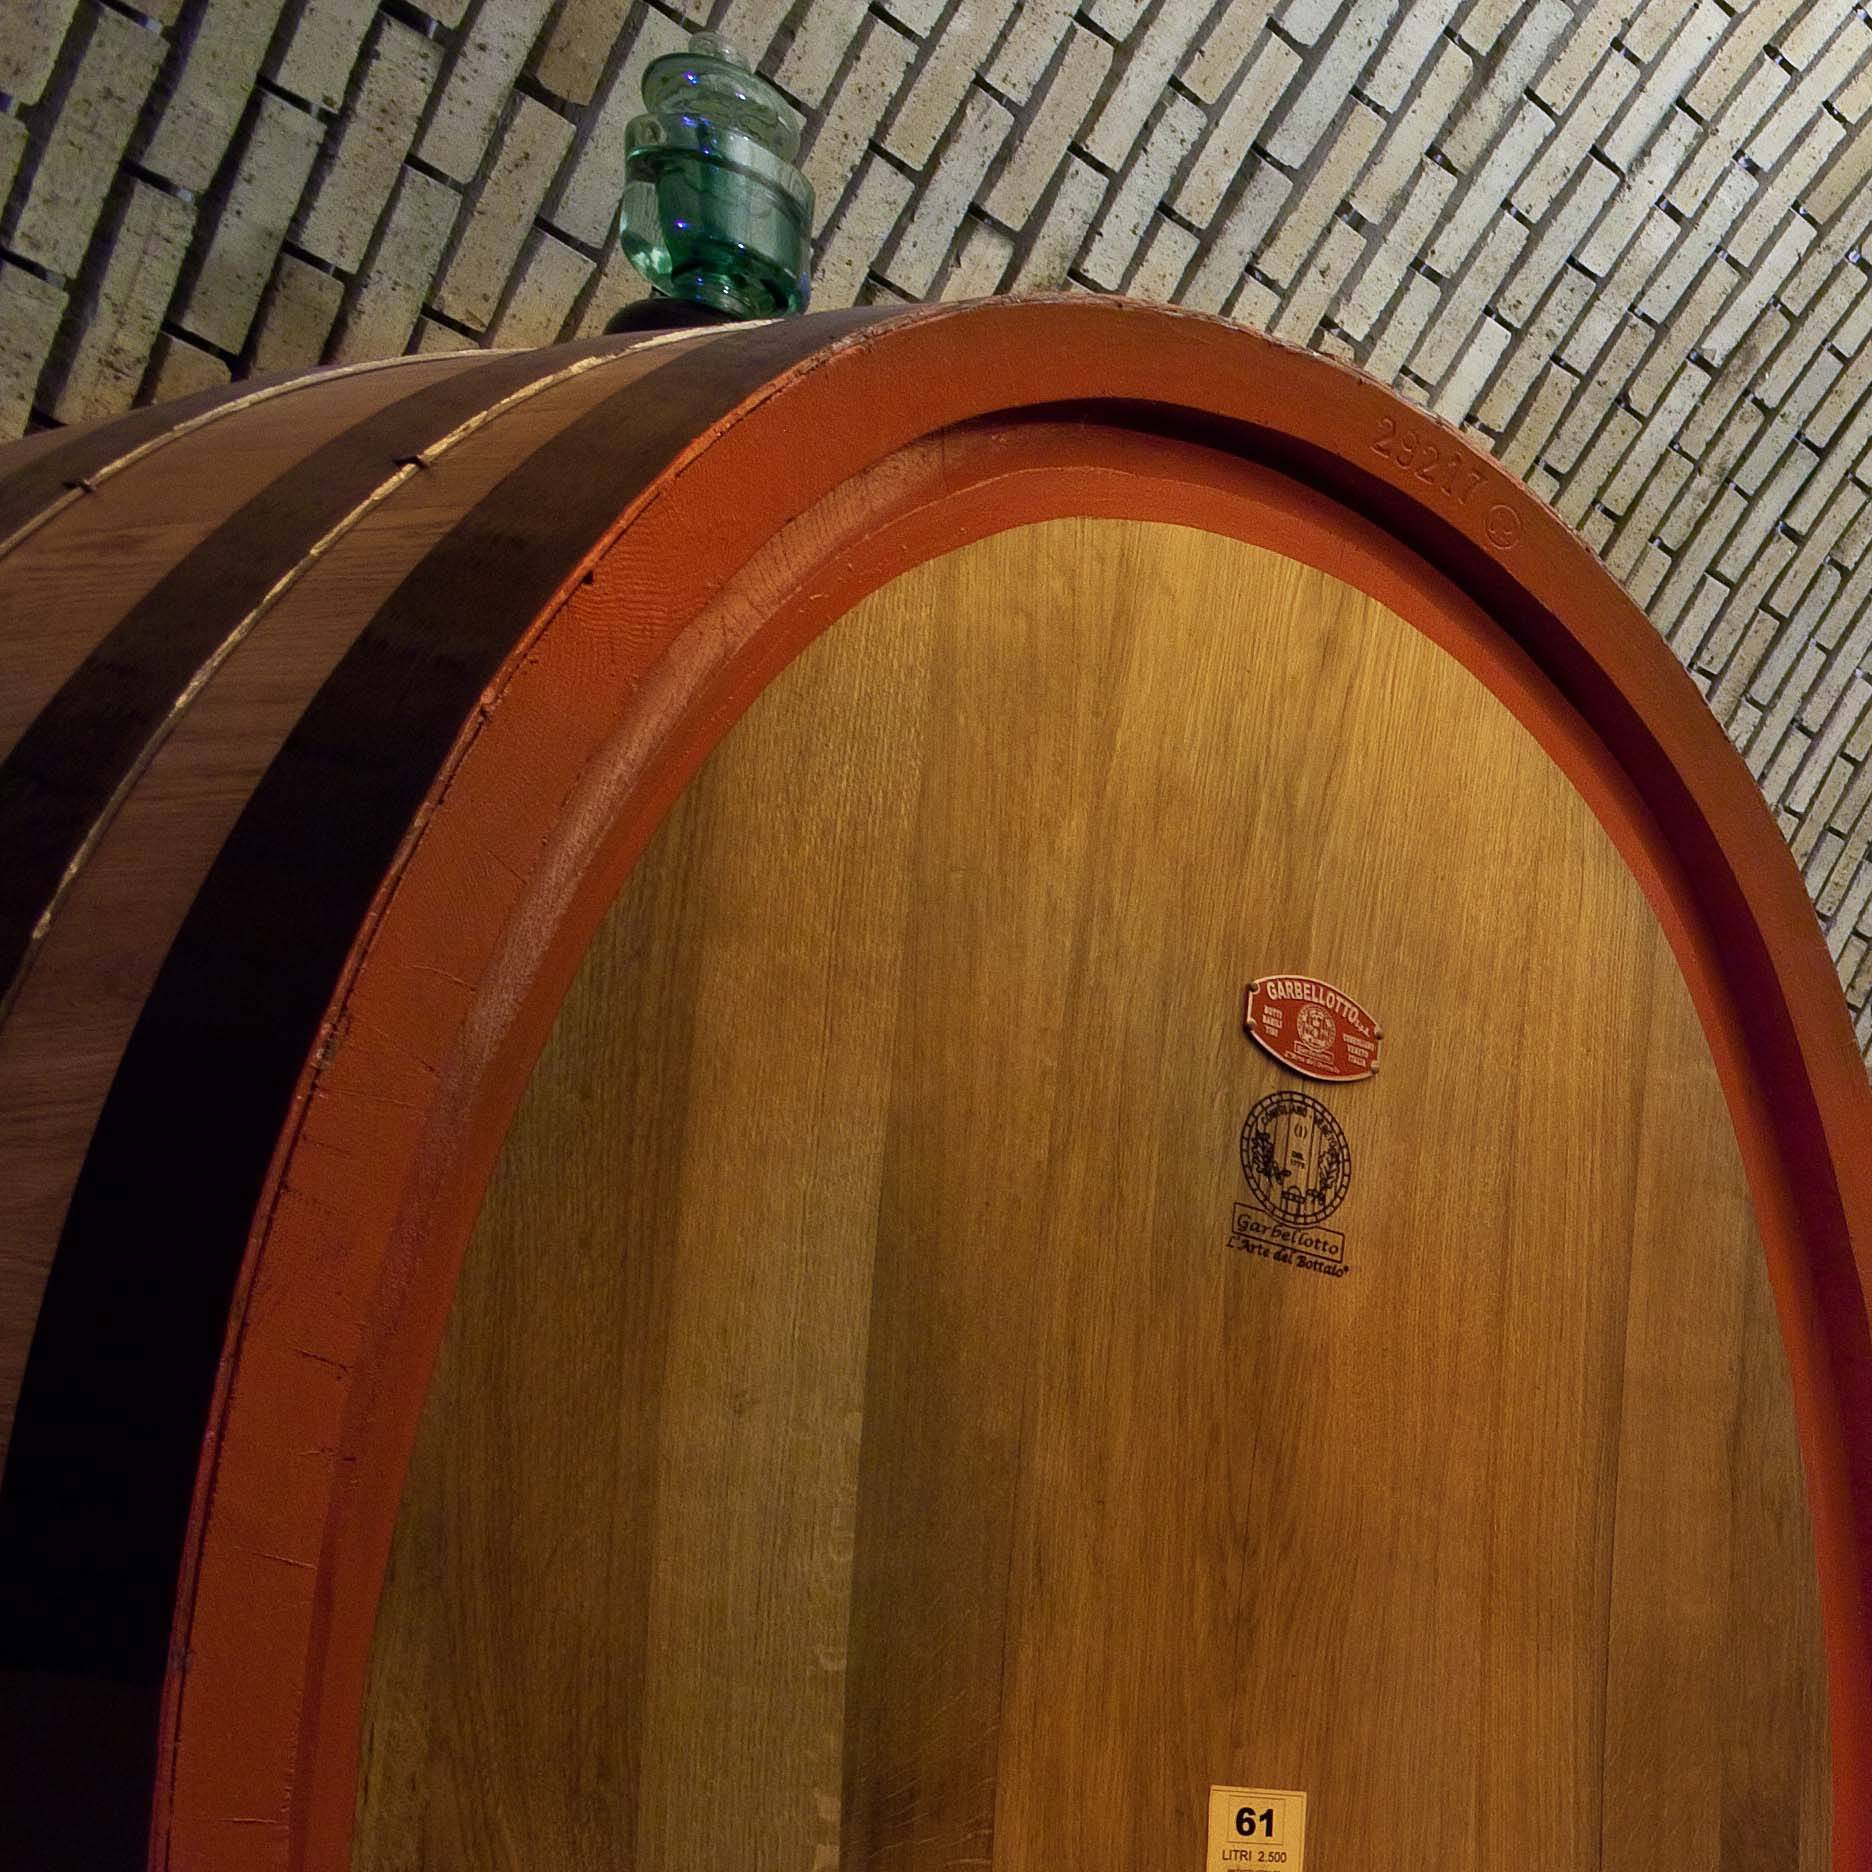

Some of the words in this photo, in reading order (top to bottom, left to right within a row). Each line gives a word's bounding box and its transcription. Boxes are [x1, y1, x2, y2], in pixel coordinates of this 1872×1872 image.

[1266, 980, 1359, 1023] GARBELLOTTO
[1237, 1214, 1339, 1254] Garbellotto
[1235, 1807, 1274, 1837] 61
[1222, 1849, 1252, 1861] LITRI
[1258, 1850, 1287, 1863] 2.500
